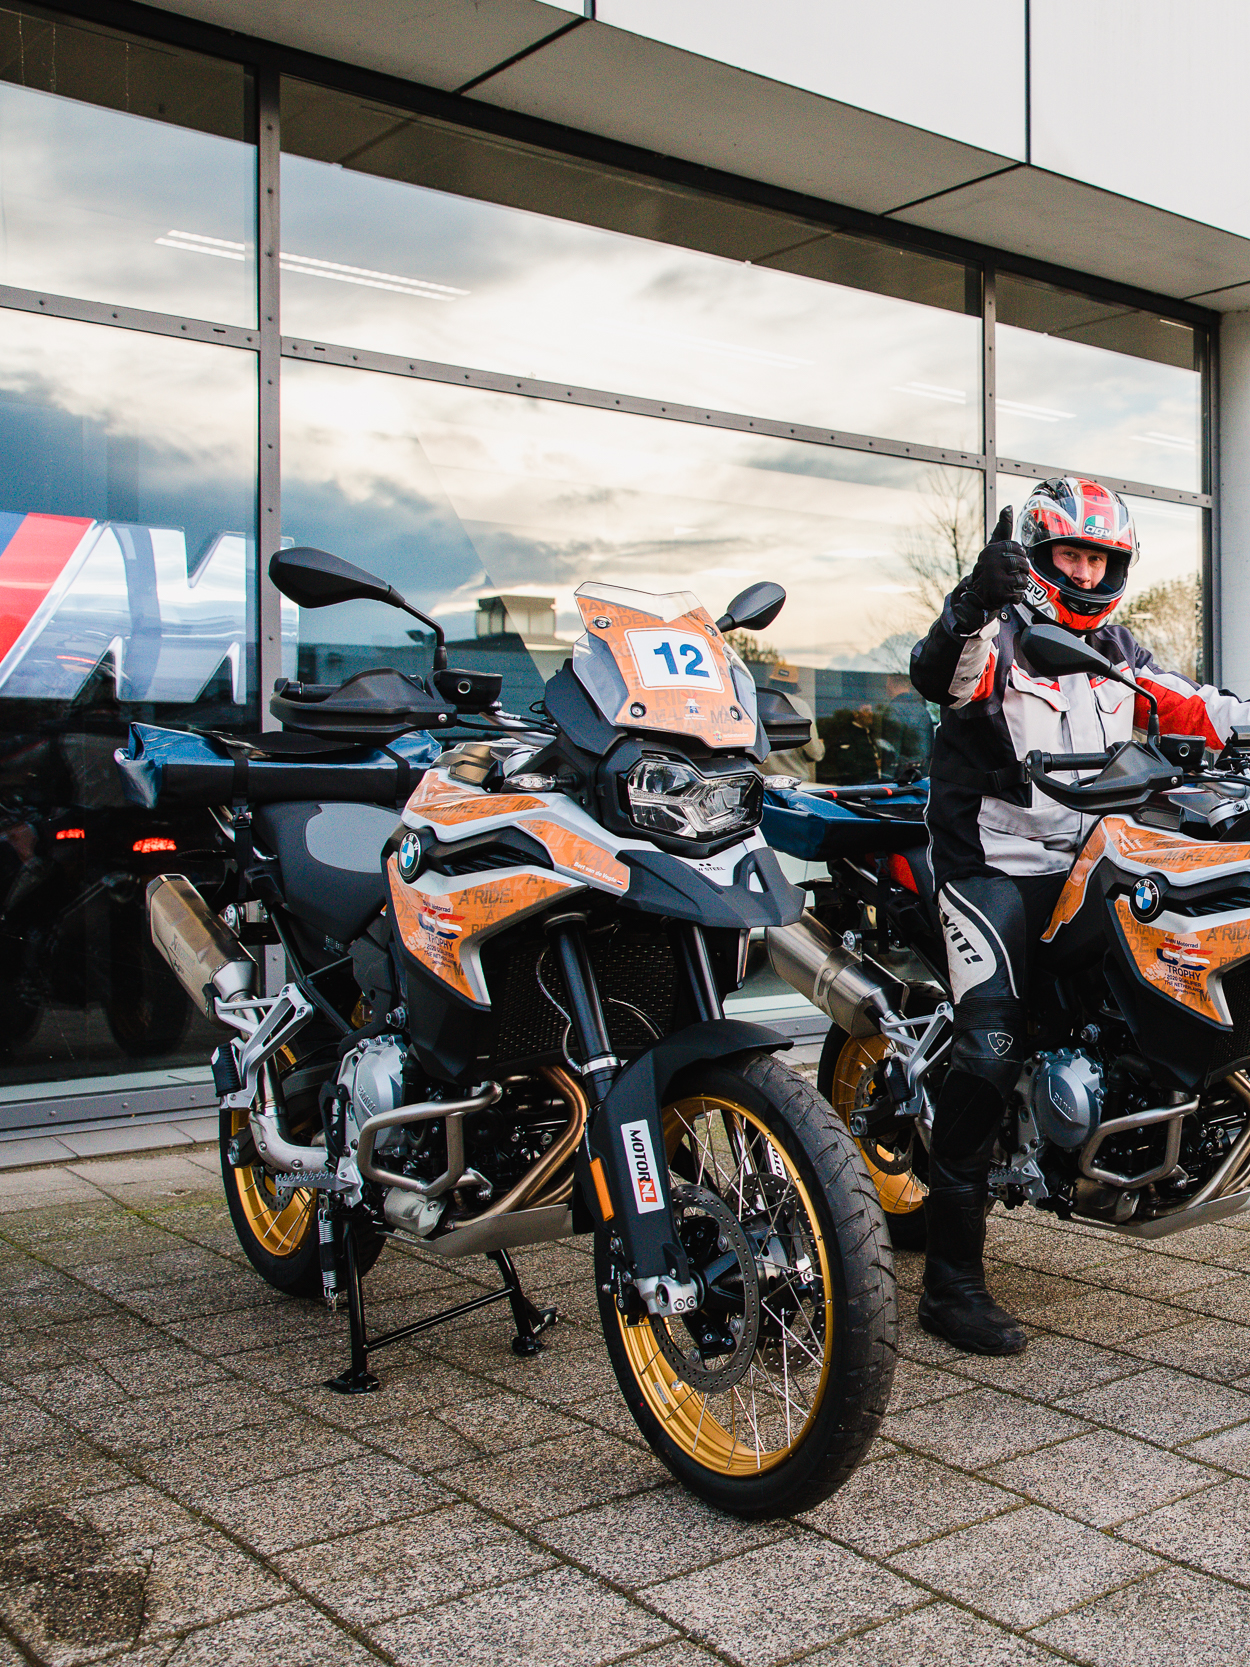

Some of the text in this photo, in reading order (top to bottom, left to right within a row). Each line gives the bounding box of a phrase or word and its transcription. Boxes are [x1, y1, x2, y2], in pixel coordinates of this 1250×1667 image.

[1085, 525, 1112, 538] agv
[1026, 580, 1043, 596] gv
[653, 641, 711, 678] 12
[401, 832, 419, 851] BMW
[1135, 880, 1158, 896] BMW
[427, 932, 454, 951] TROPHY
[1177, 940, 1198, 948] Motorrad
[1167, 964, 1201, 981] TROPHY
[629, 1129, 658, 1203] MOTORNL
